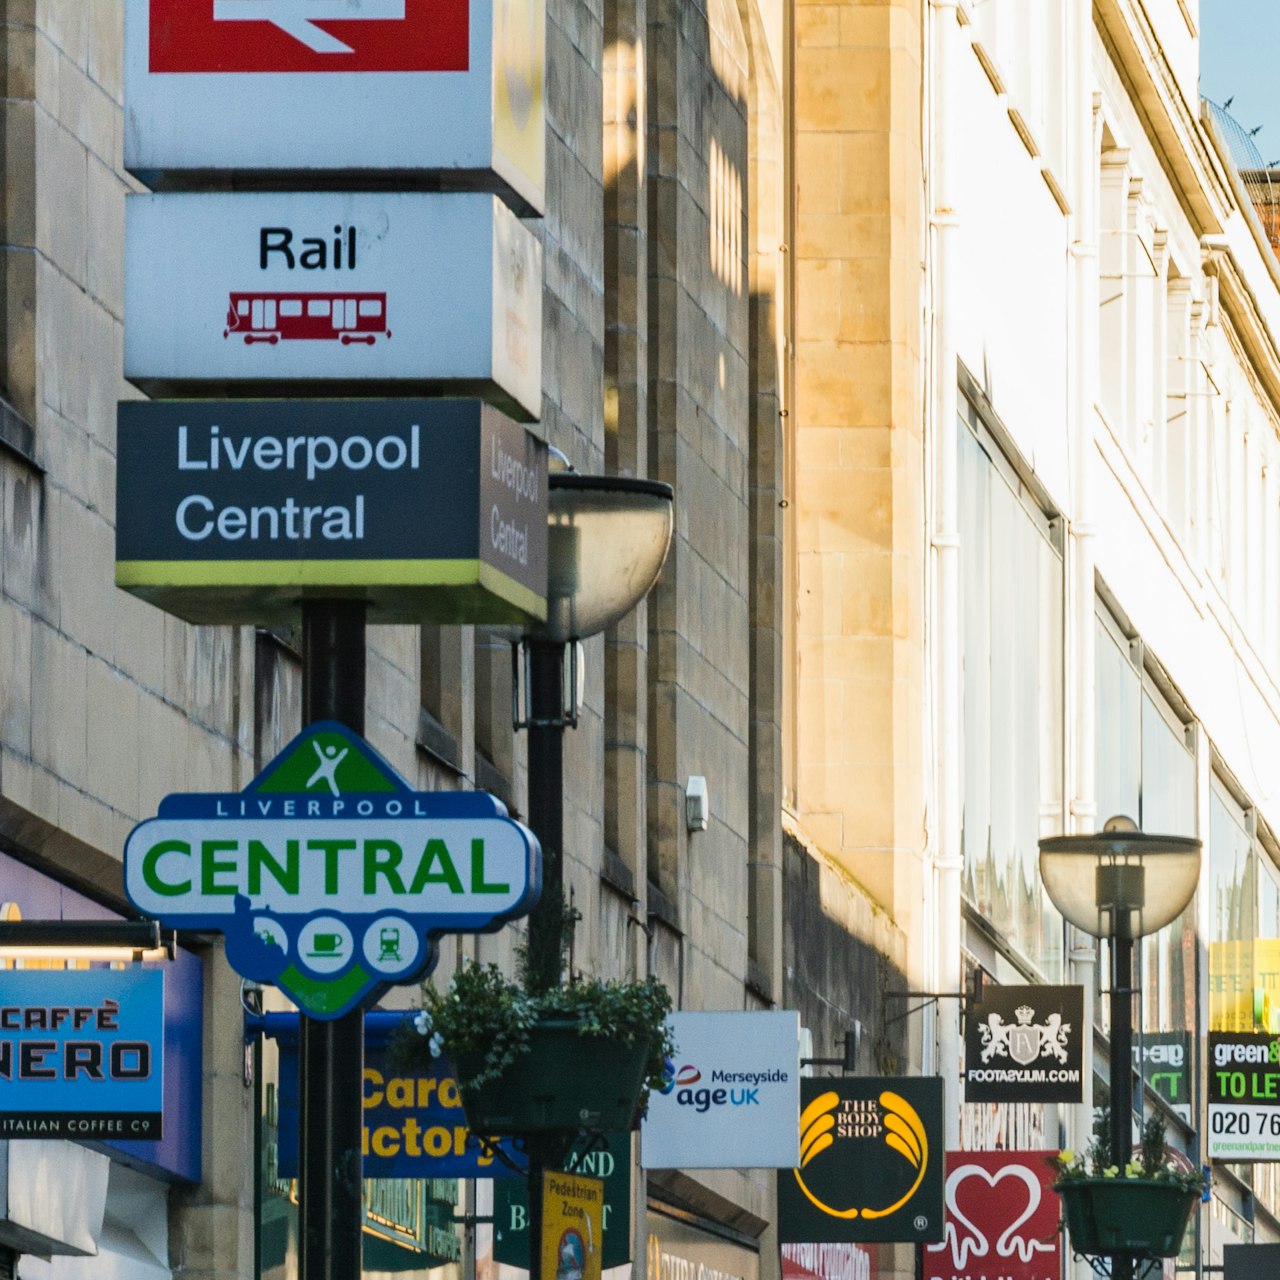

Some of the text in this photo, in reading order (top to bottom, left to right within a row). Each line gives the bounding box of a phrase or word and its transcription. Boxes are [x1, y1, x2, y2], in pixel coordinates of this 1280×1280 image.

[260, 225, 356, 270] Rail
[177, 425, 420, 480] Liverpool
[491, 433, 539, 503] Liverpool
[175, 494, 365, 541] Central
[490, 503, 528, 567] Central
[216, 799, 427, 817] LIVERPOOL
[141, 838, 511, 898] CENTRAL
[0, 998, 120, 1032] CAFFÈ
[711, 1068, 789, 1086] Merseyside
[1216, 1071, 1247, 1098] TO
[676, 1087, 760, 1113] age UK
[841, 1099, 878, 1112] THE
[2, 1118, 60, 1132] ITALIAN
[67, 1118, 123, 1132] COFFEE
[837, 1111, 882, 1125] BODY
[1211, 1111, 1251, 1135] 020
[837, 1124, 883, 1138] SHOP
[548, 1179, 598, 1202] Pedestrian
[561, 1200, 585, 1219] Zone
